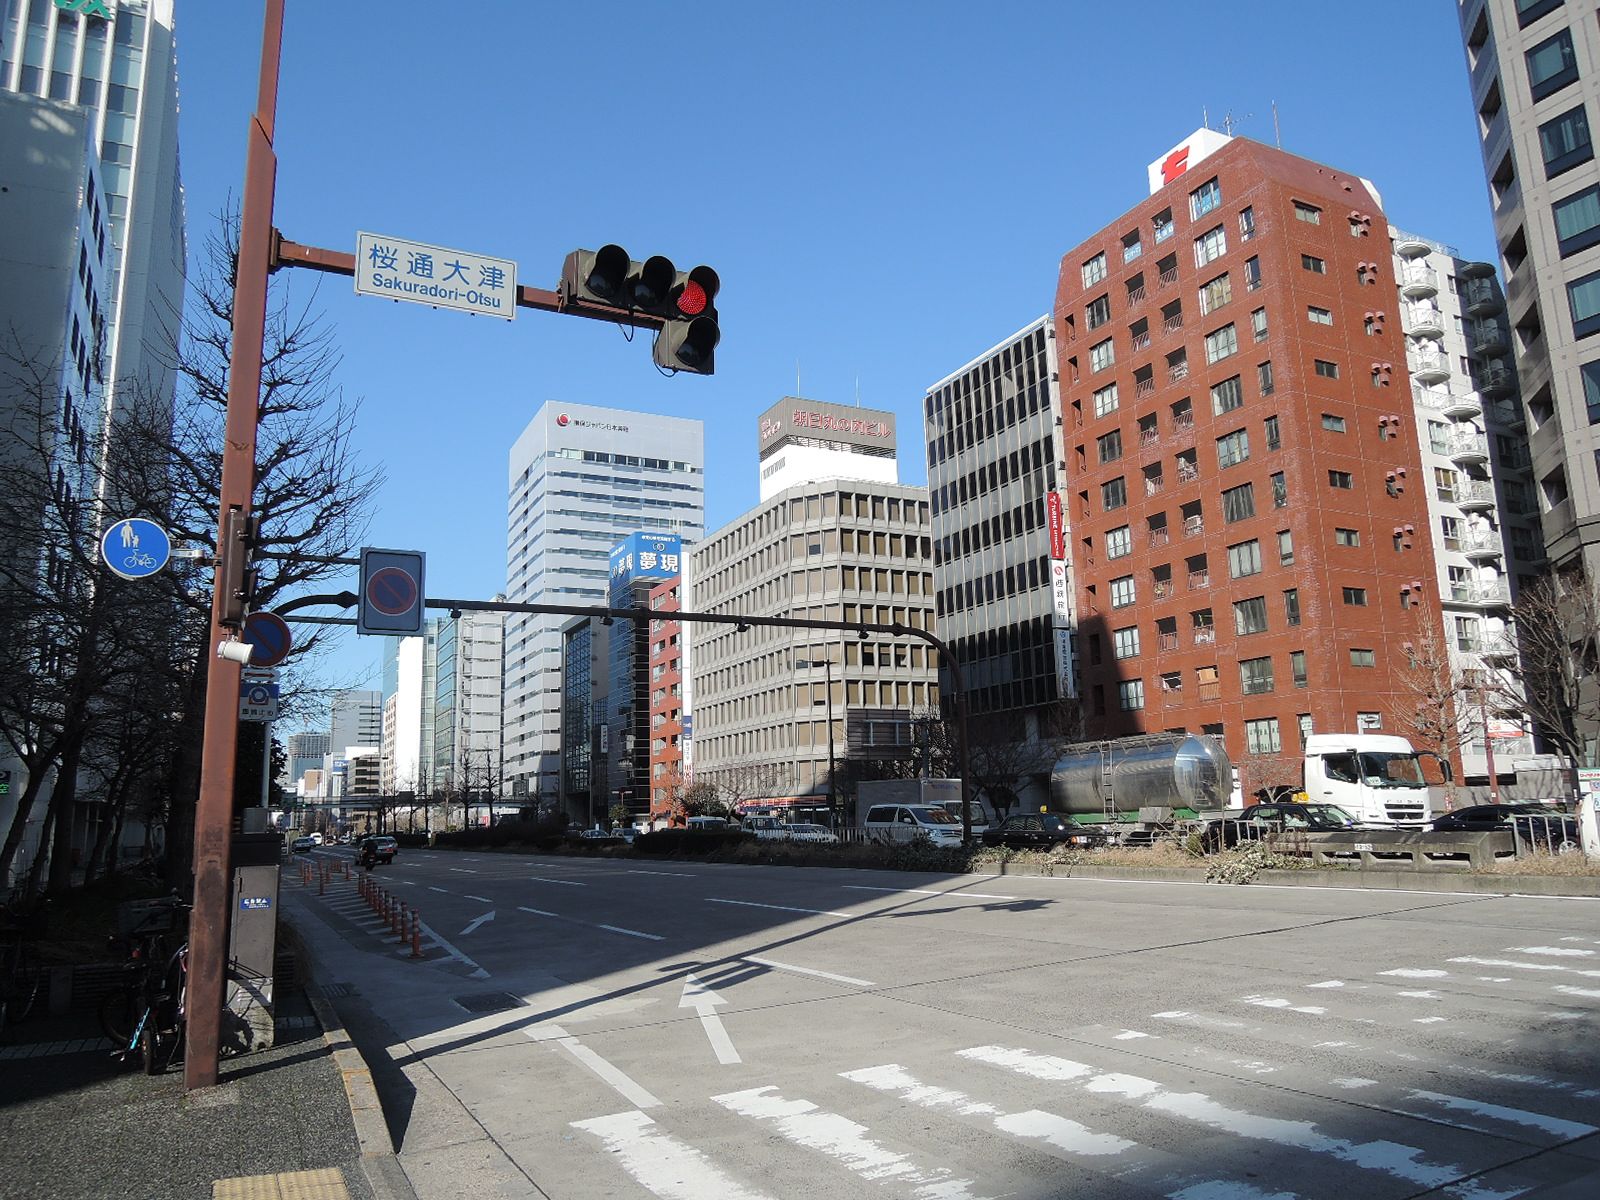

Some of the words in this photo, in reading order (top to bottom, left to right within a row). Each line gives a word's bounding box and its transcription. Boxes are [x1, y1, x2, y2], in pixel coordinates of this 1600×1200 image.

[368, 243, 505, 291] 桜通大津
[372, 273, 501, 308] Sakuradori-Otsu
[792, 409, 892, 438] 朝日丸の内ビル
[640, 552, 679, 573] 夢現
